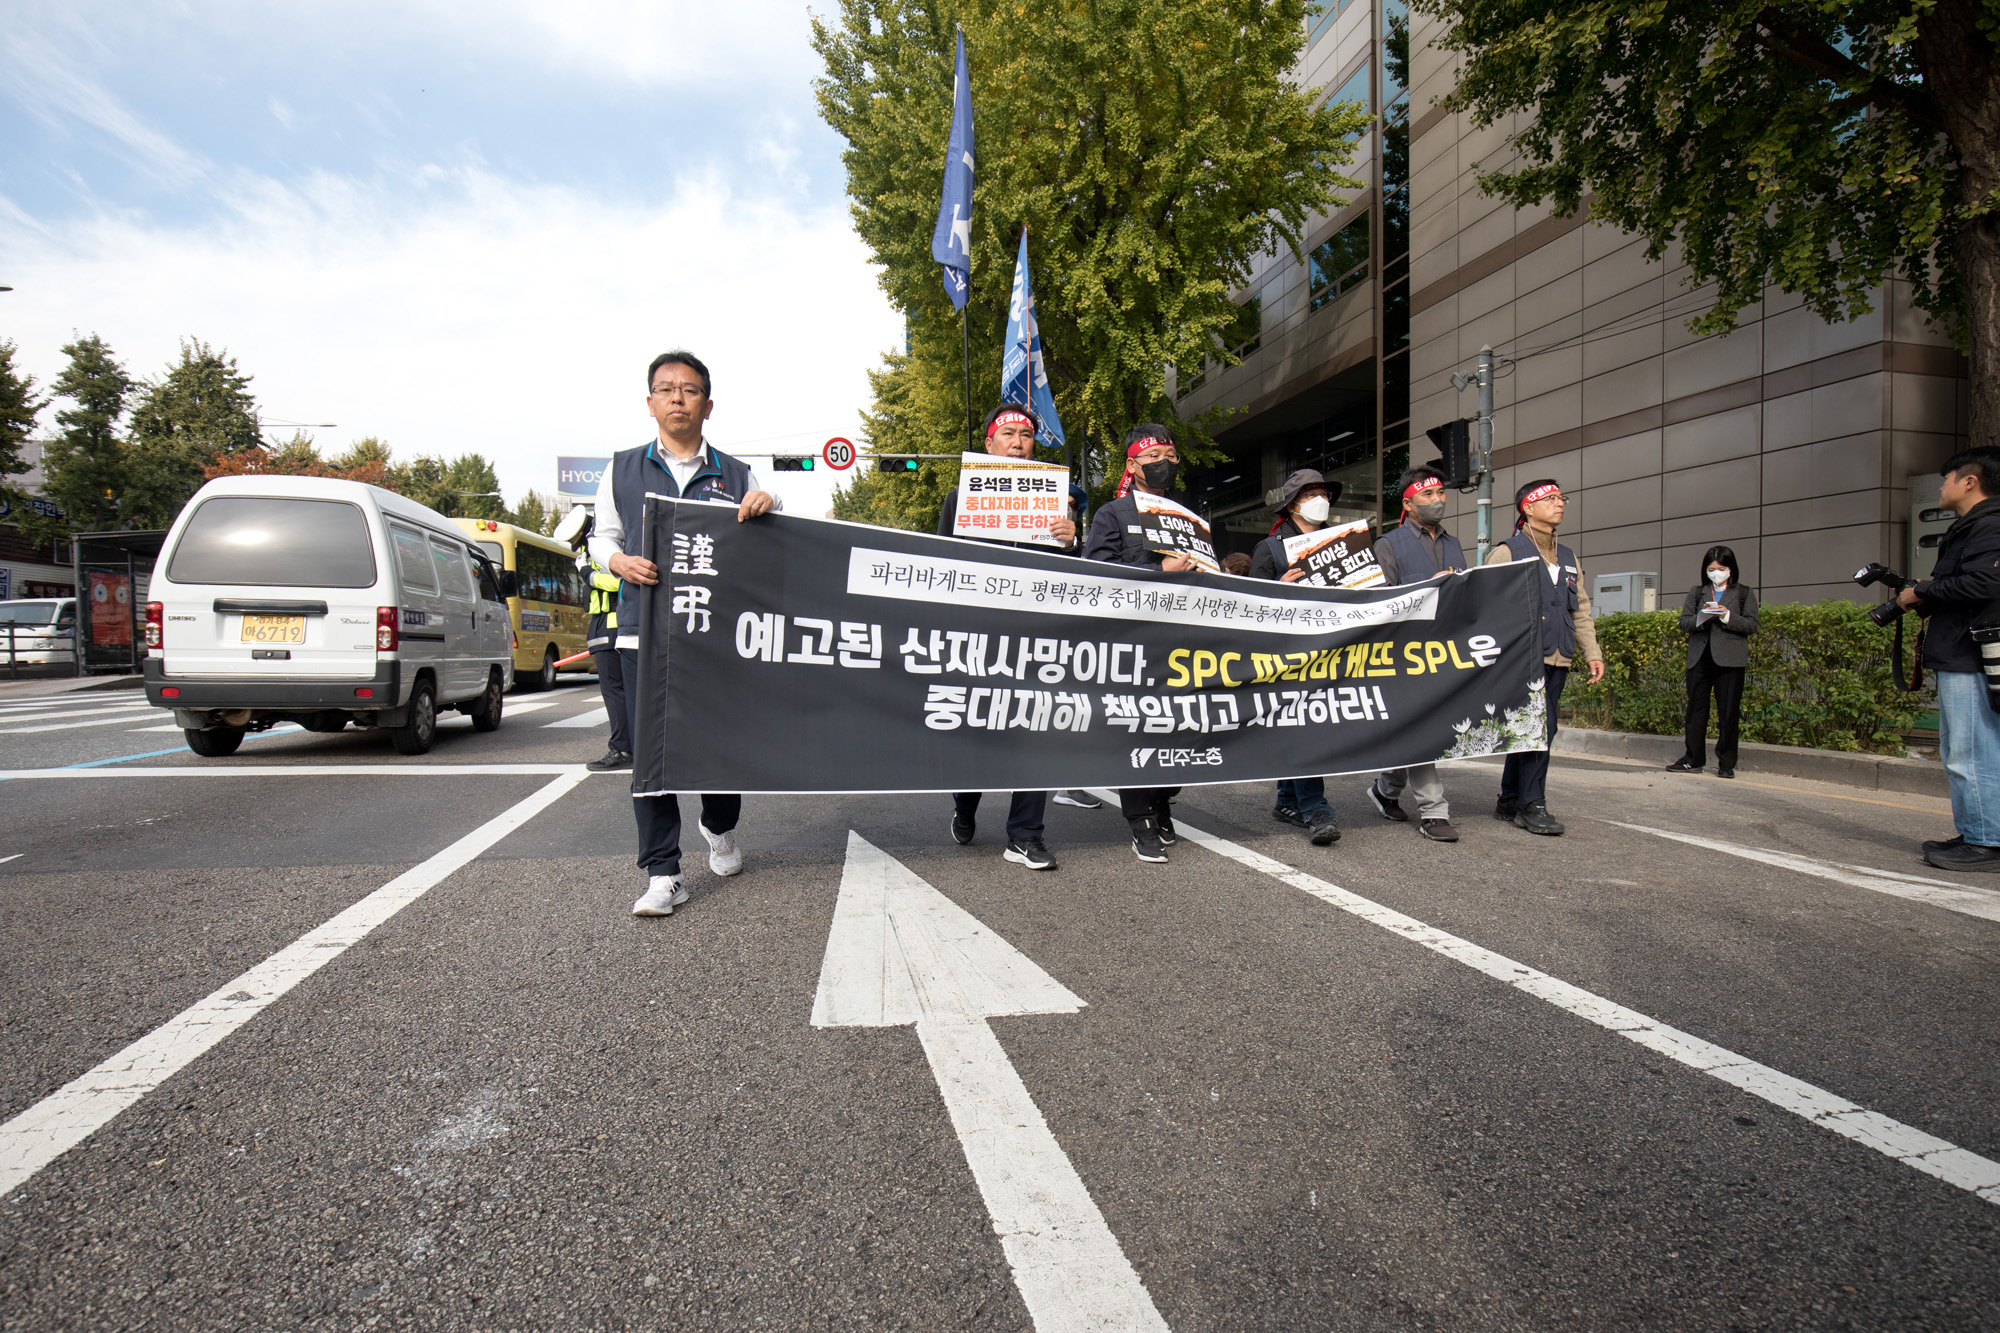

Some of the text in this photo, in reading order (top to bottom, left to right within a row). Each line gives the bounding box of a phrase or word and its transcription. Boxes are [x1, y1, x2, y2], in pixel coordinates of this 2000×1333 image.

[995, 412, 1014, 427] 단결
[830, 445, 849, 463] 50
[561, 470, 604, 483] HYOS
[968, 476, 1058, 493] 윤석열 정부는
[965, 495, 1060, 512] 중대재해 처벌
[957, 514, 1002, 529] 무력화
[1158, 515, 1196, 536] 더이상
[1144, 528, 1175, 546] 죽을
[1176, 533, 1190, 548] 수
[1189, 536, 1216, 559] 없다!
[1307, 541, 1349, 571] 더이상
[1327, 565, 1342, 580] 수
[1341, 547, 1375, 574] 없다!
[870, 561, 978, 593] 파리바게뜨
[984, 576, 1023, 597] SPL
[1031, 579, 1103, 607] 평택공장
[1107, 586, 1188, 613] 중대재해로
[1191, 595, 1238, 619] 사망한
[1239, 604, 1297, 625] 노동자의
[1298, 607, 1343, 627] 죽음을
[1346, 607, 1383, 622] 애도
[735, 611, 883, 669] 예고된
[899, 627, 1155, 687] 산재사망이다.
[1166, 648, 1243, 688] SPC
[1250, 641, 1397, 684] 파리바게뜨
[923, 684, 1390, 734] 중대재해 책임지고 사과하라!
[1157, 746, 1224, 767] 민주노총
